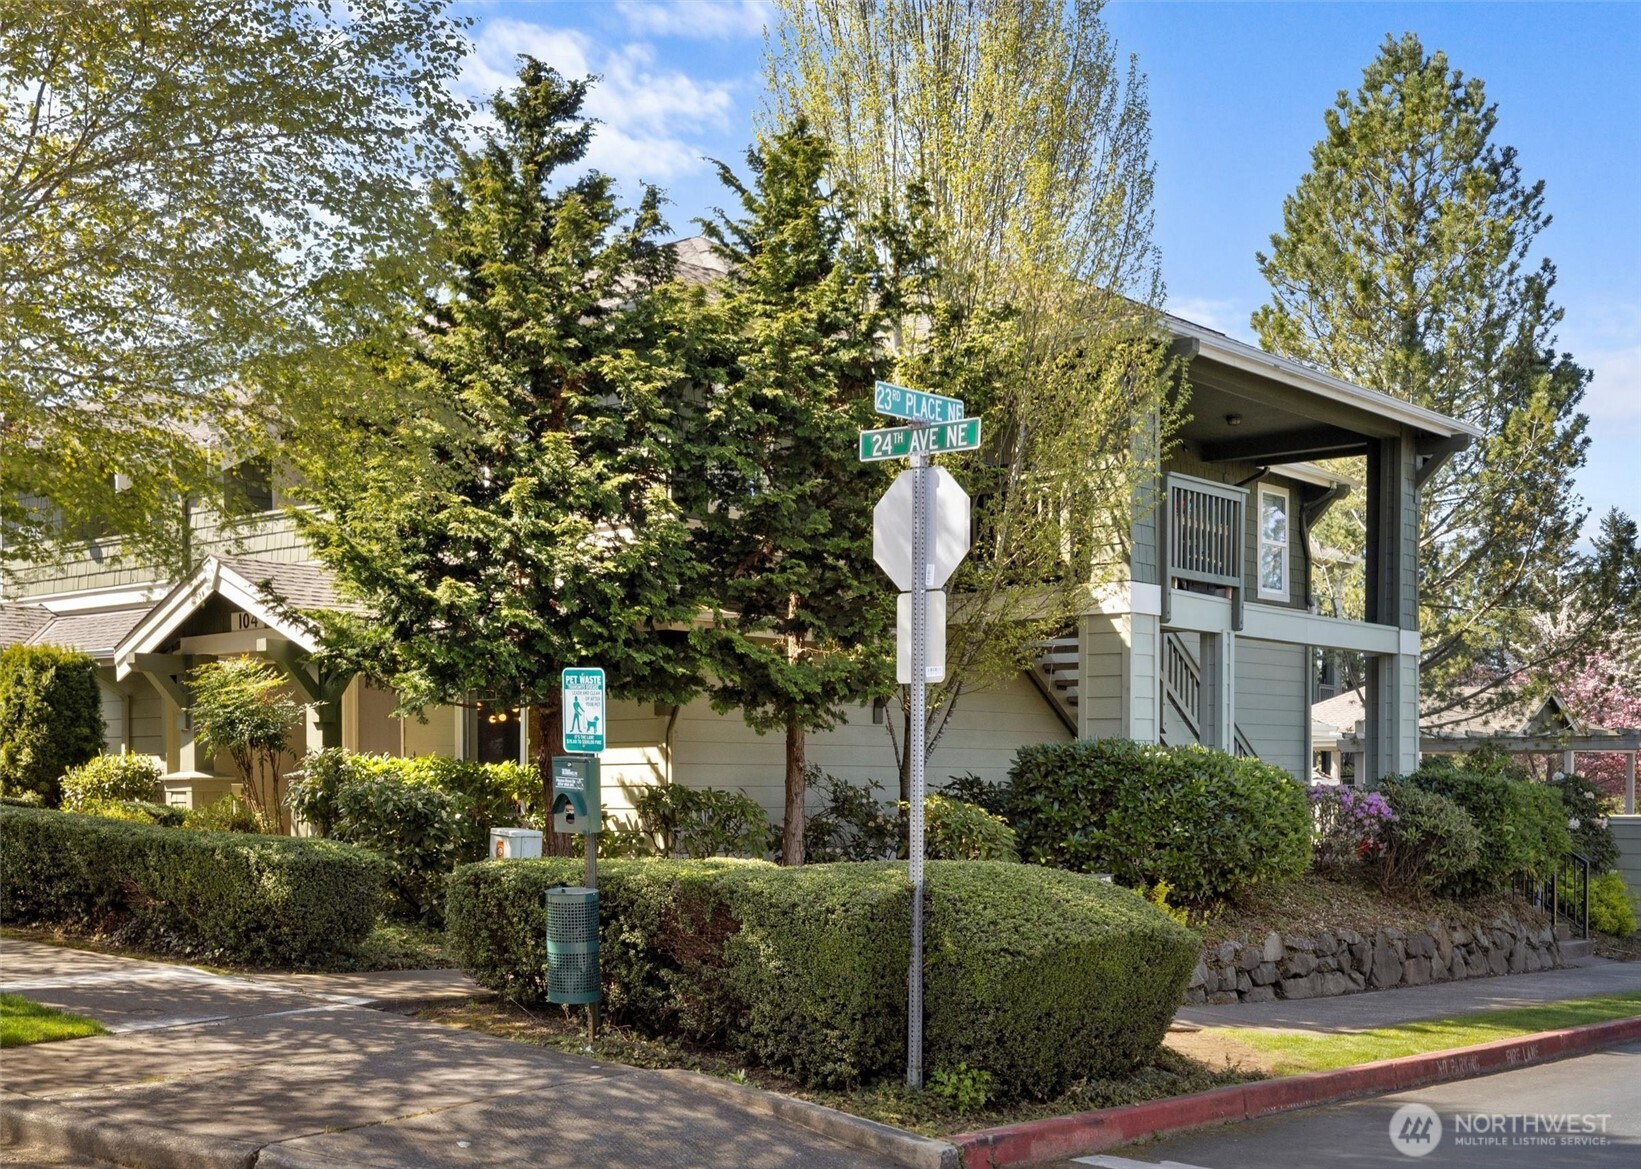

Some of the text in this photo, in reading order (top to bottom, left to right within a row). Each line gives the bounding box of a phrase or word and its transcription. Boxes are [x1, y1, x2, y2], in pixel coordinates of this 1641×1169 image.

[876, 385, 963, 422] 23RD PLACE NE
[872, 424, 968, 457] 24TH AVE NE
[565, 675, 601, 685] PET WASTE
